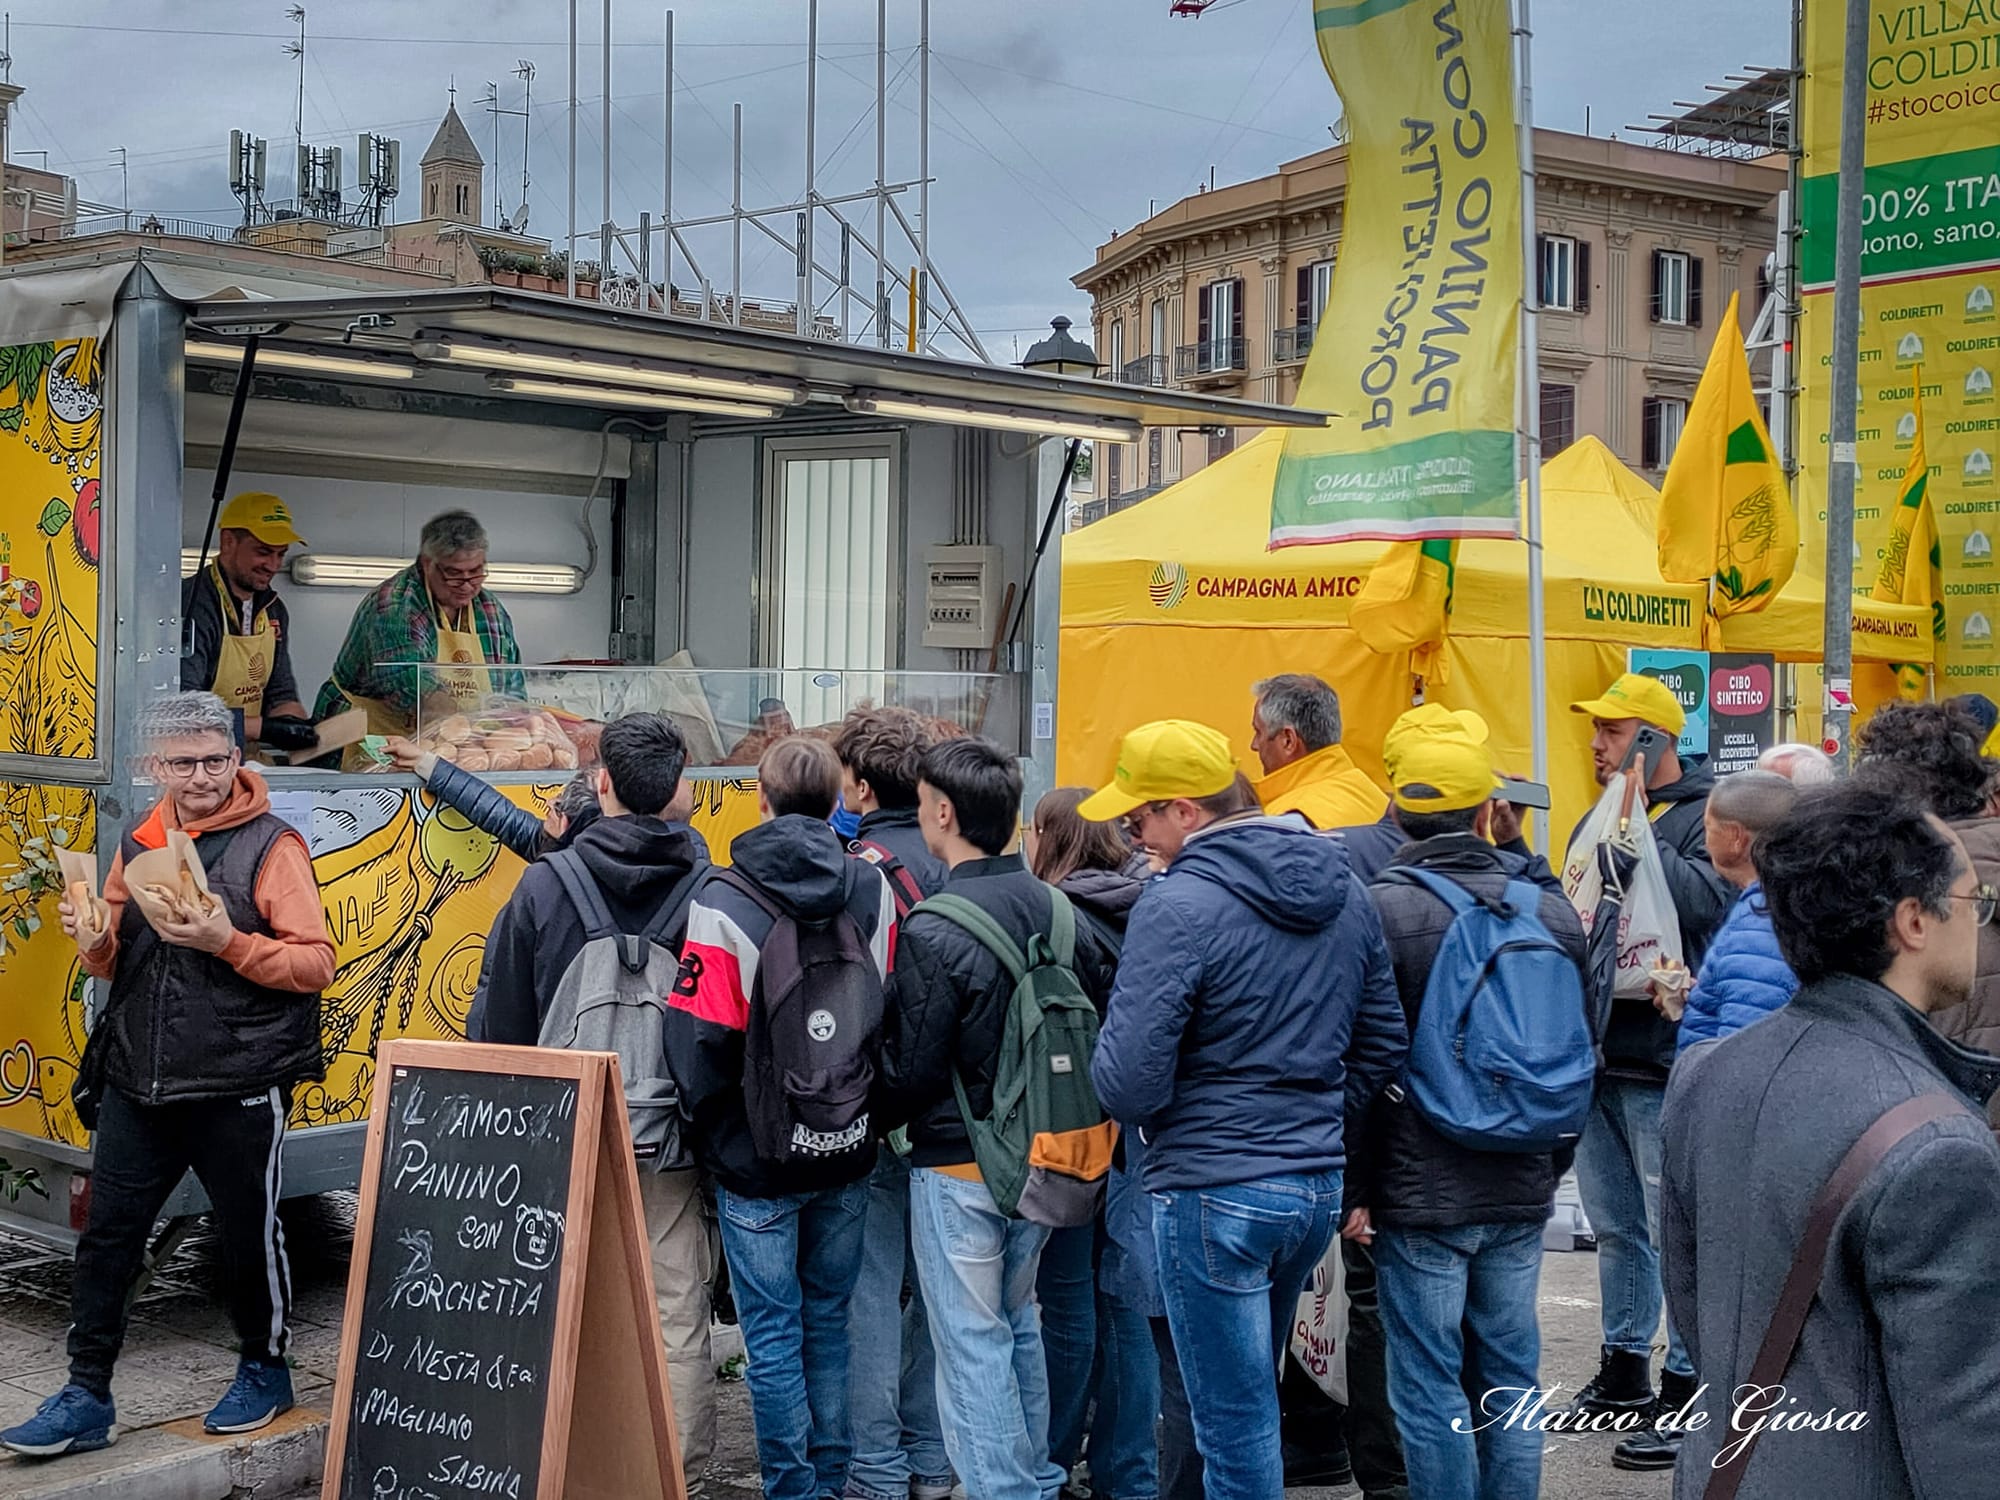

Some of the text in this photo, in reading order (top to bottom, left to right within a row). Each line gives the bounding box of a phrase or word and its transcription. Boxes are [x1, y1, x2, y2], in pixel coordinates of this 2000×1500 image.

[1868, 34, 2000, 91] COLDI
[1861, 184, 1931, 226] 00%
[1860, 231, 1924, 256] uono,
[1879, 304, 1944, 322] COLDIRETTI
[1820, 350, 1882, 367] COETTI
[1196, 576, 1362, 599] CAMPAGNA AMIC
[1606, 590, 1691, 628] COLDIRETTI
[1852, 615, 1919, 639] CAMPAGNA AMICA
[1729, 675, 1751, 689] CIBO
[1716, 690, 1763, 705] SINTETICO
[1747, 733, 1755, 744] LA
[394, 1139, 521, 1207] PANINO
[457, 1215, 503, 1250] CON
[403, 1335, 481, 1385] NESTA
[361, 1387, 473, 1441] MAGLIANO
[427, 1454, 522, 1500] SABINA
